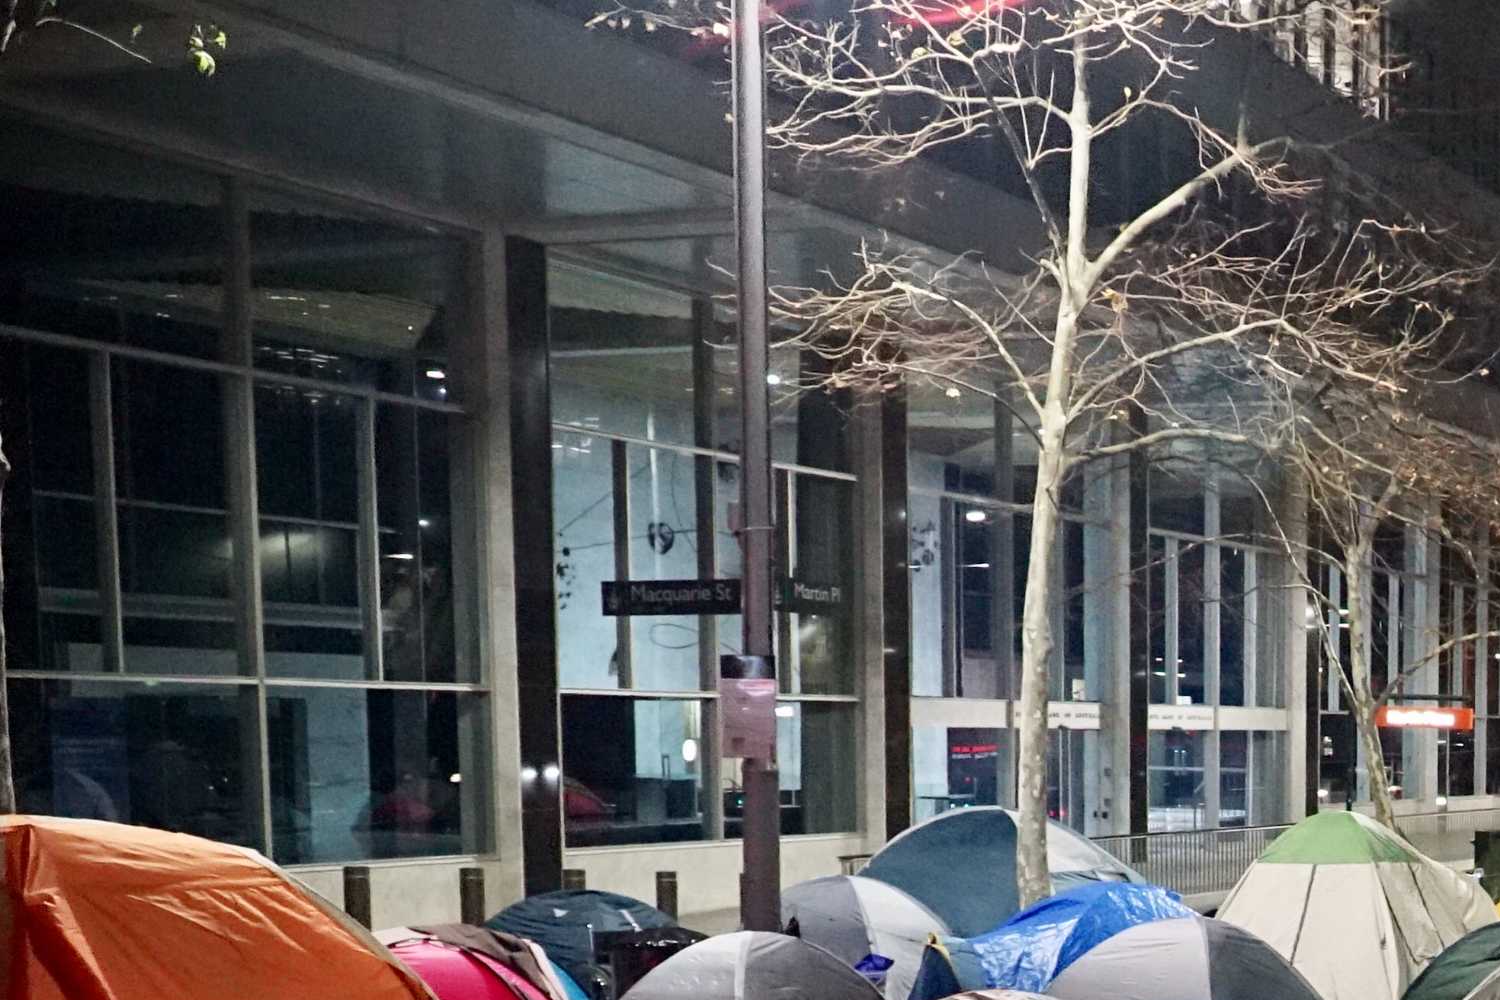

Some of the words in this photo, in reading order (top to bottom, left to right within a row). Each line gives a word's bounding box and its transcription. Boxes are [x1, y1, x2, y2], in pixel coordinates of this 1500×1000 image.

[631, 584, 711, 605] Macquarie
[715, 583, 732, 601] St
[794, 582, 829, 601] Martin
